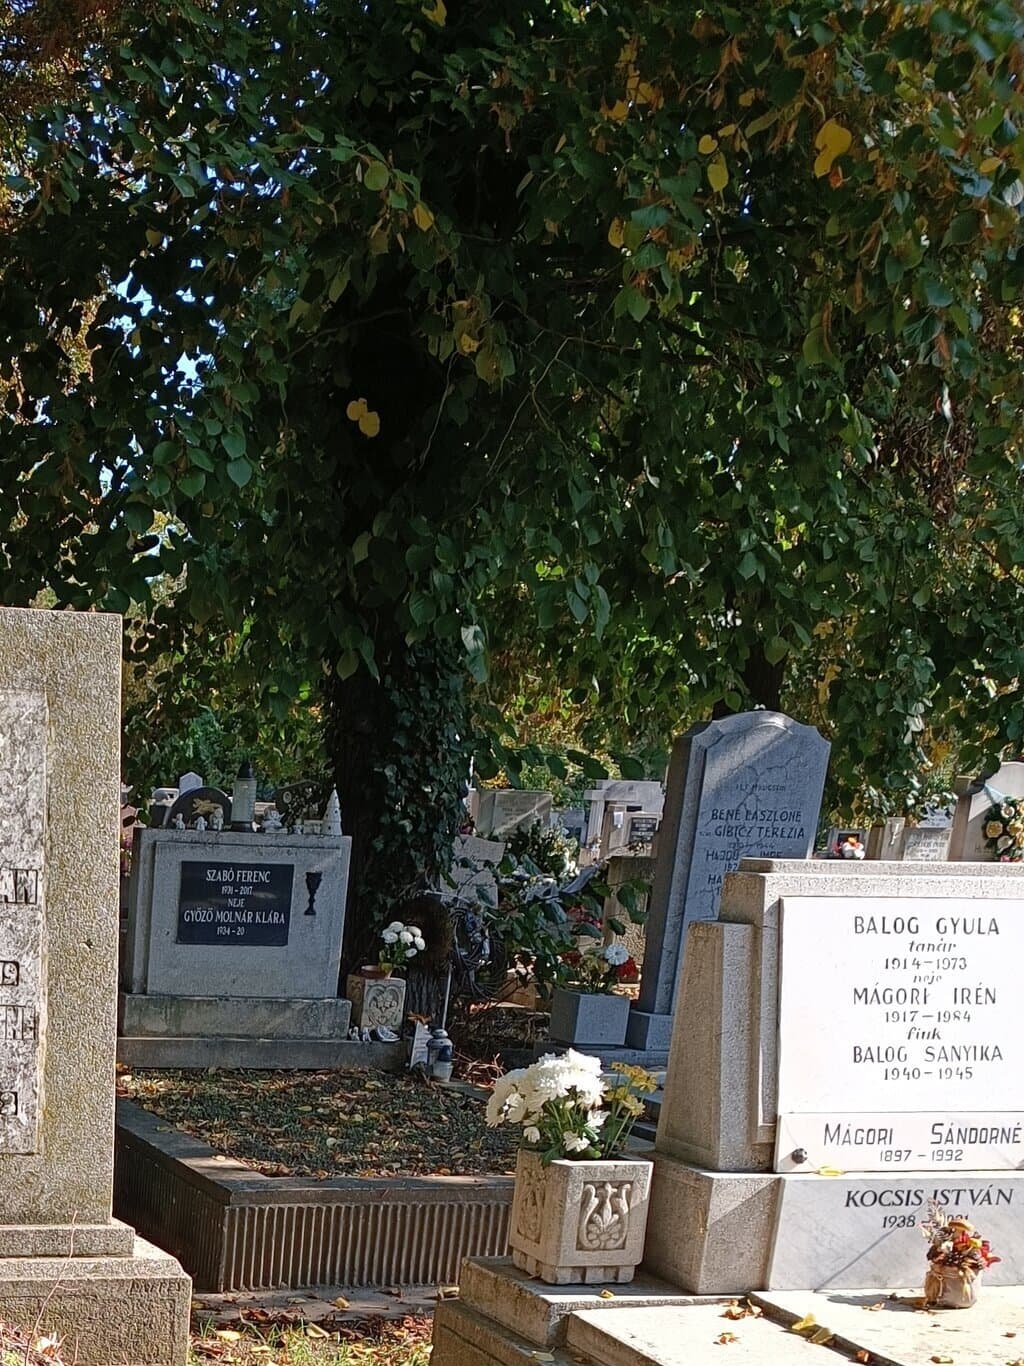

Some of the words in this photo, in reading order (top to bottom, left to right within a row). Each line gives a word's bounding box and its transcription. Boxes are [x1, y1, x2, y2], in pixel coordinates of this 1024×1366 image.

[206, 867, 235, 882] SZABÓ
[236, 870, 271, 883] FERENC
[239, 886, 253, 895] 2017
[227, 897, 246, 908] NEJE
[183, 906, 214, 923] GYŐZŐ
[215, 909, 254, 924] MOLNÁR
[255, 909, 285, 924] KLÁRA
[854, 915, 919, 935] BALOG
[935, 916, 1000, 936] GYULA
[908, 937, 957, 953] tanár
[913, 970, 942, 984] neje
[853, 981, 928, 1006] MÁGORI
[953, 981, 997, 1006] IRÉN
[853, 1045, 908, 1064] BALOG
[924, 1044, 1004, 1063] SANYIKA
[823, 1122, 894, 1146] MÁGORI
[930, 1121, 1023, 1146] SÁNDORNÉ
[879, 1149, 913, 1162] 1897
[931, 1148, 964, 1162] 1992
[845, 1189, 925, 1208] KOCSIS
[932, 1183, 1014, 1206] ISTVÁN
[882, 1215, 916, 1229] 1938
